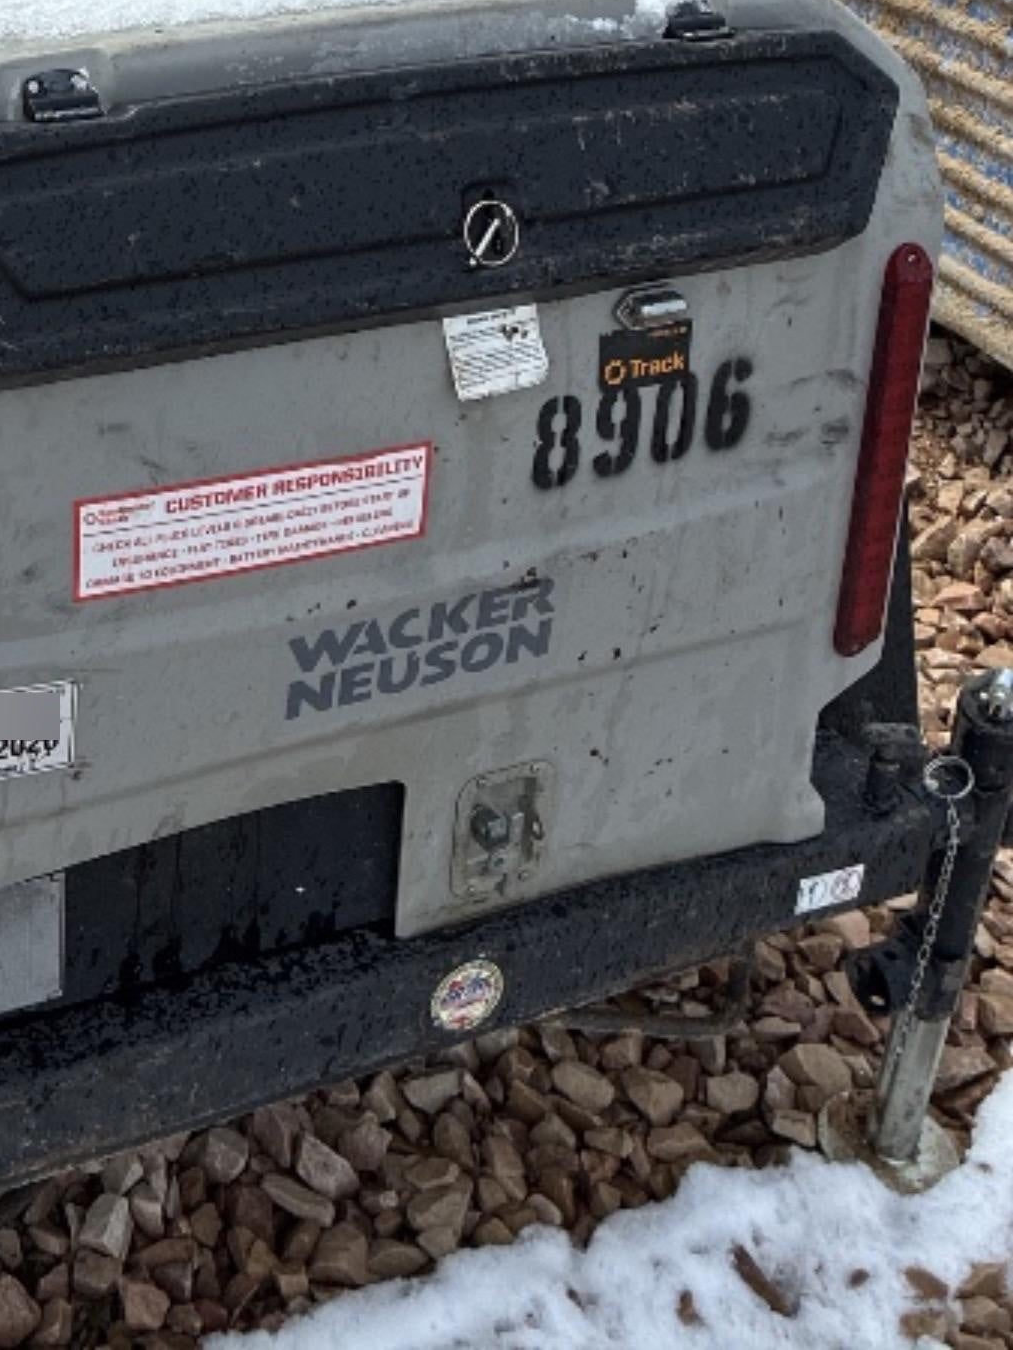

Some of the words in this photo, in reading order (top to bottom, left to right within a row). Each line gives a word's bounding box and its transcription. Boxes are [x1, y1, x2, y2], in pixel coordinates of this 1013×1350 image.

[531, 356, 754, 490] 8906
[165, 484, 268, 514] CUSTOMER
[272, 455, 423, 496] RESPONSIBILITY
[285, 618, 553, 721] NEUSON
[288, 577, 555, 673] WACKER
